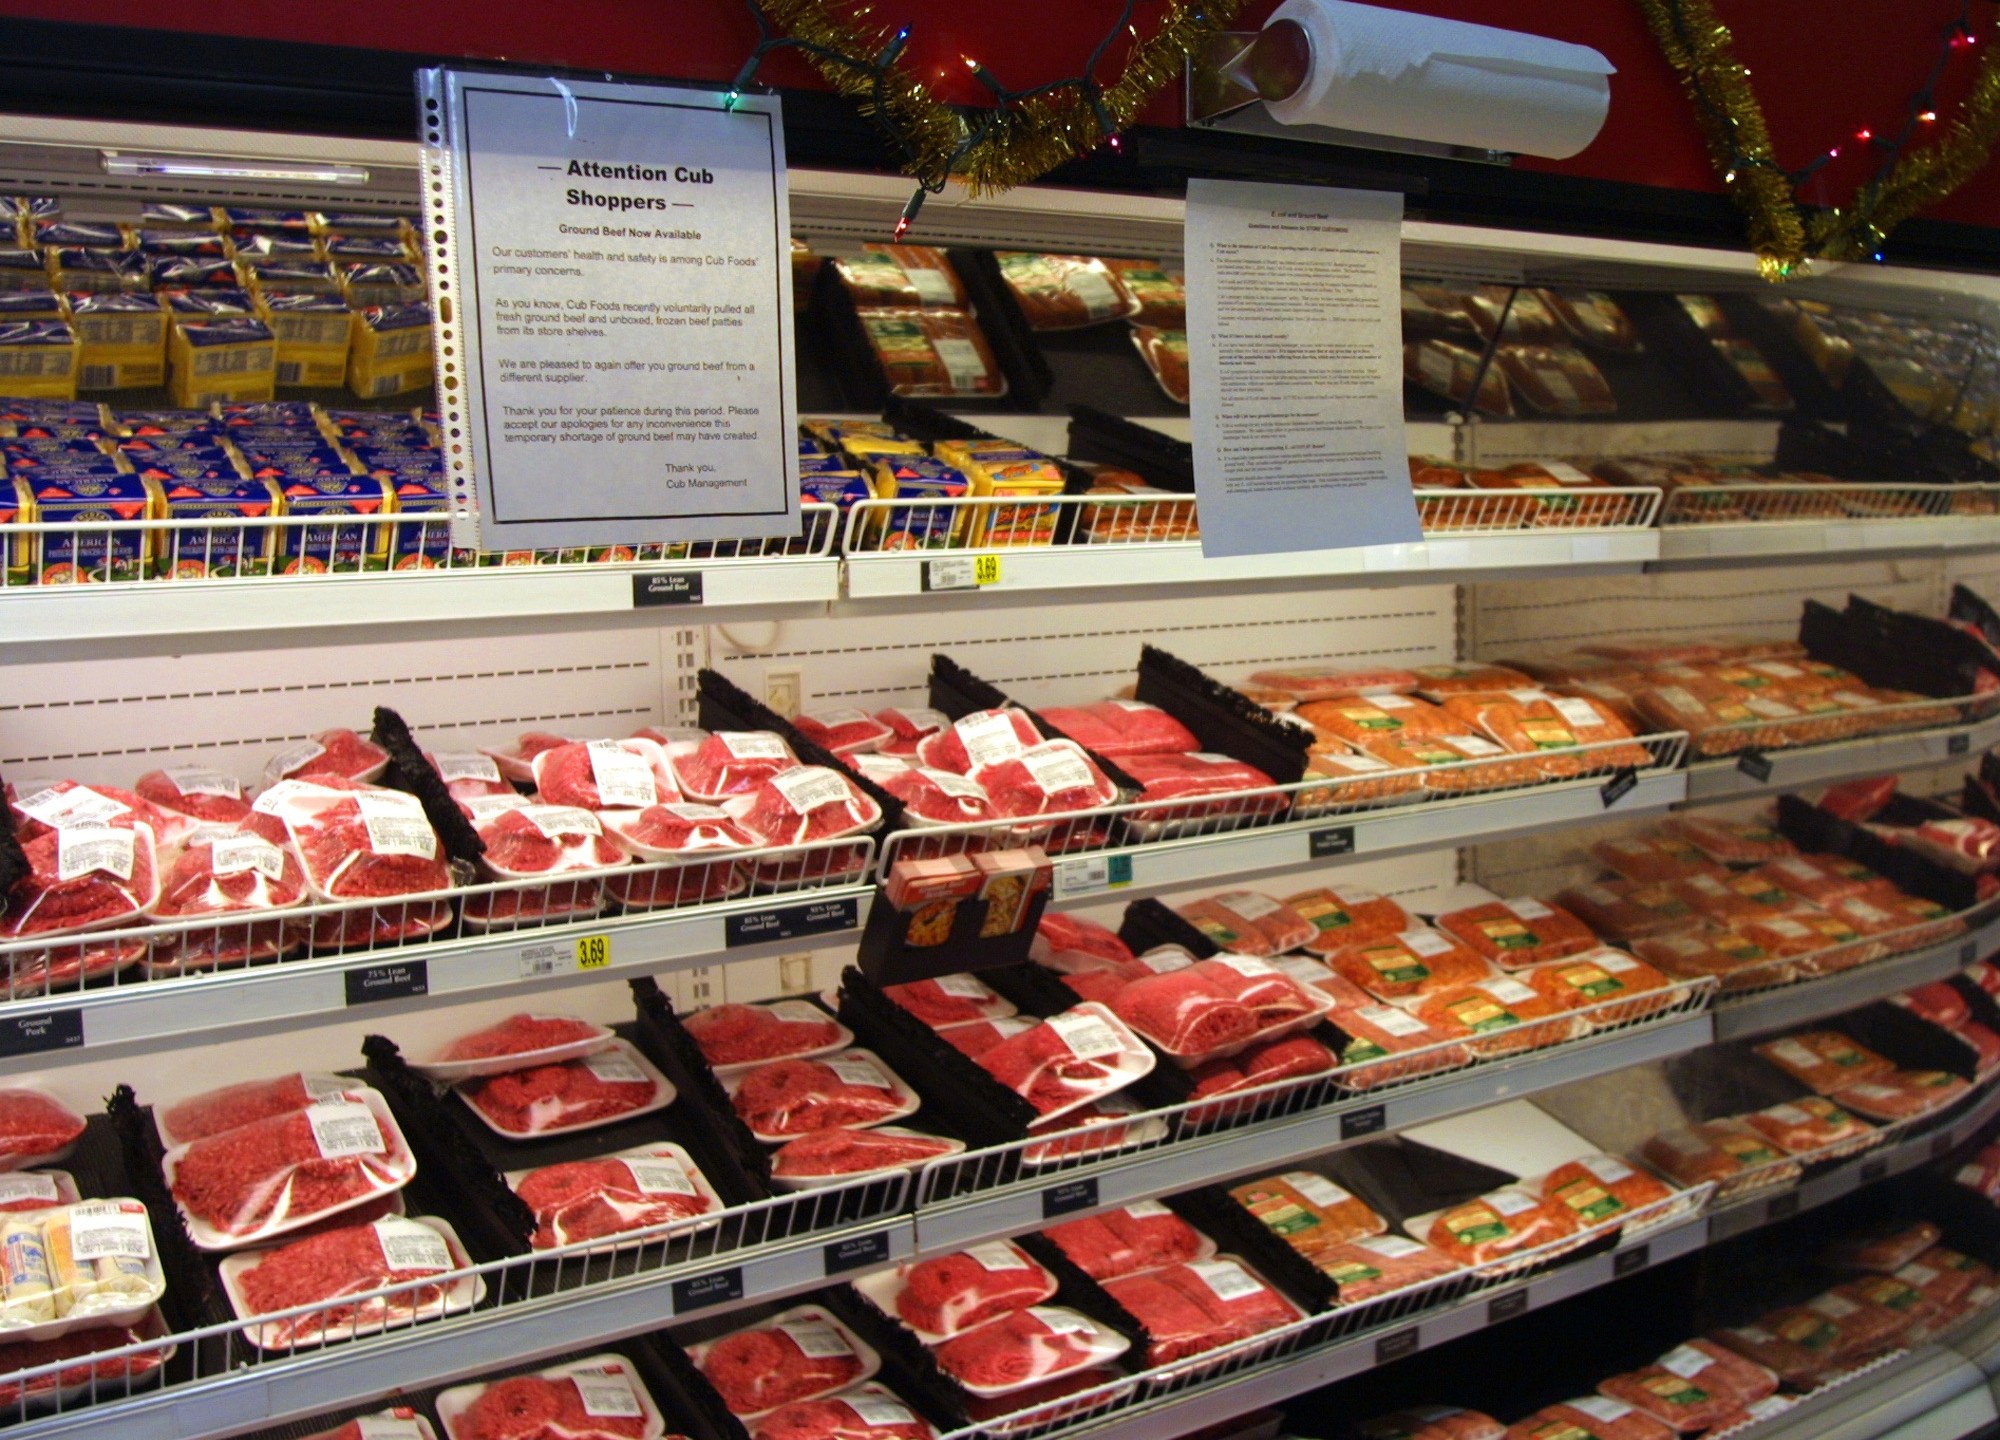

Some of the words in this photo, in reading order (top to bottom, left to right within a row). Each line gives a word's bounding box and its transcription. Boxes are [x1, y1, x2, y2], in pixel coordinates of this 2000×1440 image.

[567, 160, 667, 183] Attention
[674, 166, 714, 184] Cub
[566, 189, 667, 212] Shoppers
[559, 223, 599, 237] Ground
[602, 225, 627, 238] Beef
[628, 227, 652, 239] Now
[655, 227, 701, 241] Available
[492, 246, 511, 257] Our
[574, 250, 603, 261] health
[606, 252, 624, 262] and
[628, 253, 656, 265] safety
[659, 254, 667, 263] is
[670, 256, 702, 267] among
[705, 255, 724, 266] Cub
[493, 265, 532, 277] primary
[496, 299, 508, 308] As
[512, 301, 531, 311] you
[567, 301, 587, 311] Cub
[590, 301, 620, 311] Foods
[623, 303, 660, 314] recently
[663, 304, 711, 315] voluntarily
[714, 304, 741, 316] pulled
[744, 304, 754, 314] all
[496, 312, 521, 322] fresh
[525, 313, 560, 326] ground
[563, 313, 585, 323] beef
[589, 314, 607, 324] and
[656, 316, 686, 325] frozen
[689, 316, 709, 326] beef
[712, 316, 742, 328] patties
[497, 326, 519, 335] from
[523, 326, 534, 335] its
[538, 327, 563, 336] store
[498, 359, 517, 369] We
[520, 361, 536, 369] are
[540, 360, 579, 371] pleased
[582, 360, 591, 369] to
[595, 361, 621, 372] again
[624, 360, 645, 370] offer
[648, 362, 665, 373] you
[668, 361, 700, 373] ground
[702, 361, 724, 370] beef
[726, 361, 746, 370] from
[749, 363, 755, 371] a
[500, 372, 542, 382] different
[545, 372, 588, 383] supplier.
[503, 406, 535, 416] Thank
[538, 408, 556, 418] you
[560, 406, 573, 416] for
[576, 408, 597, 418] your
[600, 406, 641, 418] patience
[643, 406, 672, 418] during
[675, 406, 691, 416] this
[728, 406, 759, 415] Please
[504, 420, 538, 431] accept
[541, 421, 557, 429] our
[560, 419, 608, 431] apologies
[611, 419, 624, 428] for
[627, 421, 643, 431] any
[646, 419, 712, 428] inconvenience
[715, 419, 730, 428] this
[504, 433, 556, 444] temporary
[560, 431, 603, 443] shortage
[606, 431, 615, 441] of
[618, 431, 650, 443] ground
[653, 431, 674, 440] beef
[676, 433, 696, 443] may
[698, 431, 720, 440] have
[665, 463, 694, 473] Thank
[666, 479, 685, 489] Cub
[688, 478, 747, 489] Management
[669, 576, 685, 584] Lean
[648, 583, 673, 592] Ground
[675, 582, 689, 591] Beef
[741, 922, 765, 932] Ground
[766, 919, 780, 928] Beef
[580, 938, 605, 965] 3.69
[387, 968, 406, 976] Lean
[363, 976, 393, 988] Ground
[394, 973, 411, 983] Beef
[18, 1015, 53, 1029] Ground
[26, 1026, 46, 1036] Pork
